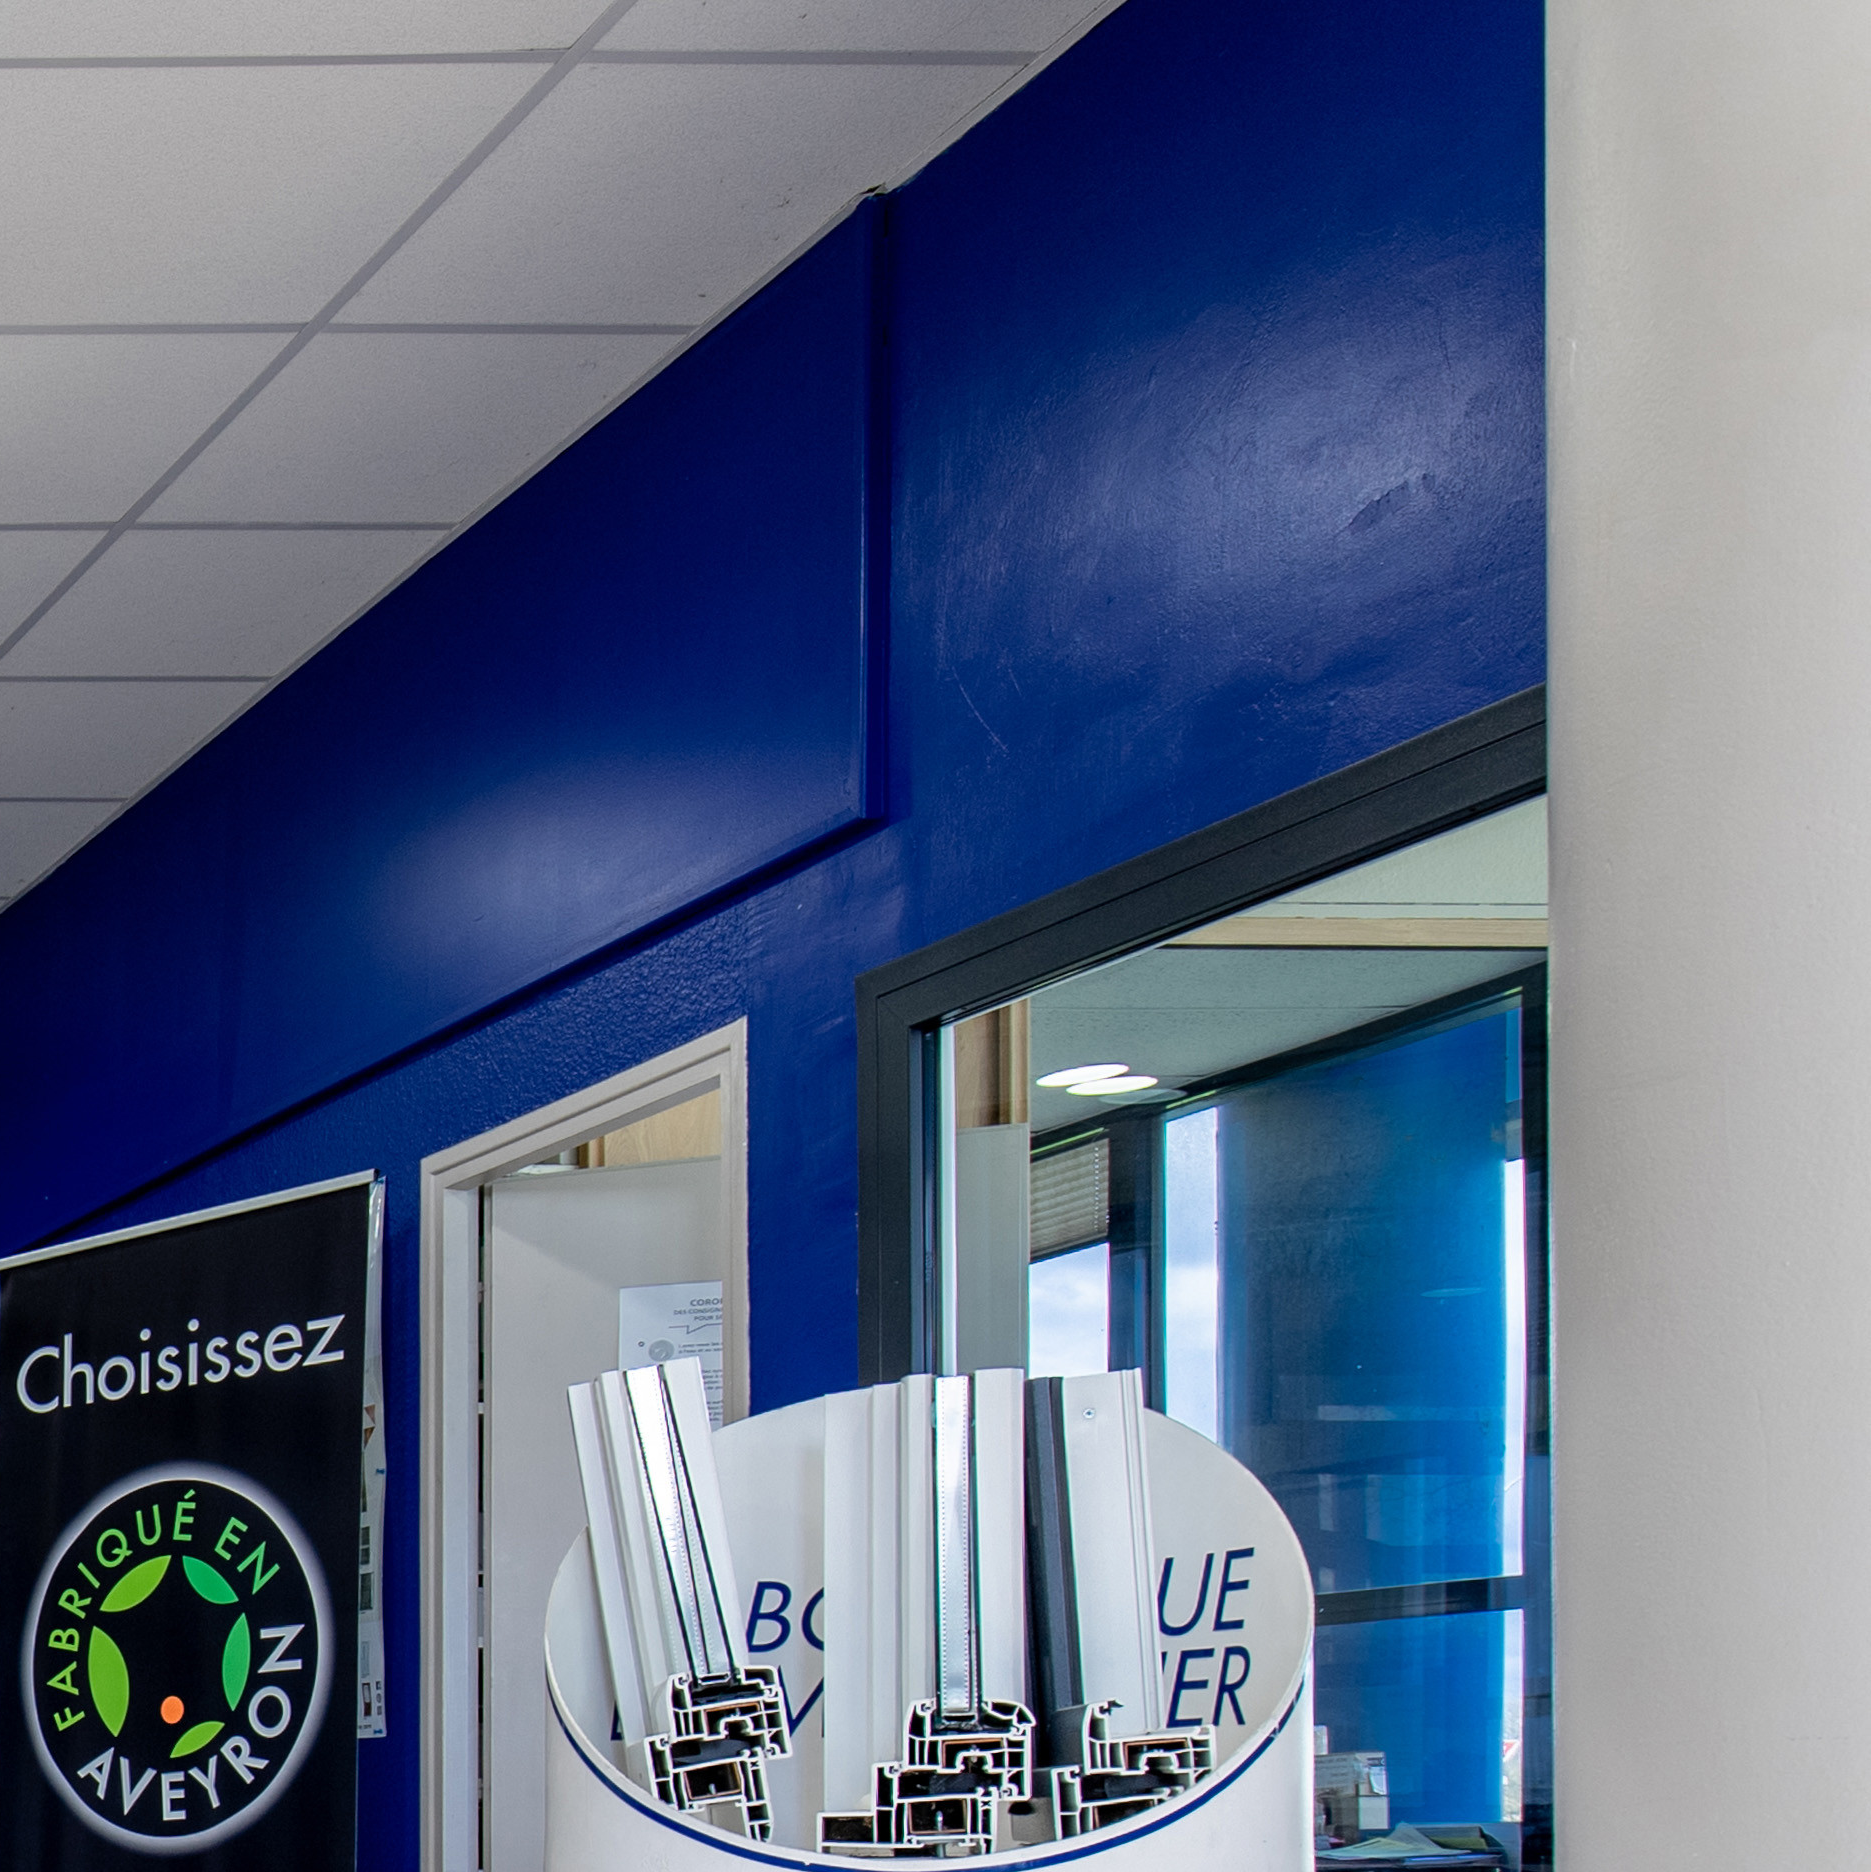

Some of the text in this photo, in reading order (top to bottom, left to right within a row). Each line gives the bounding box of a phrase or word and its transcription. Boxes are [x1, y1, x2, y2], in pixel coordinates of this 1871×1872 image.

[690, 1298, 722, 1306] CORO
[16, 1313, 346, 1414] Choisissez
[46, 1488, 305, 1821] FABRIQUÉ EN AVEYRON
